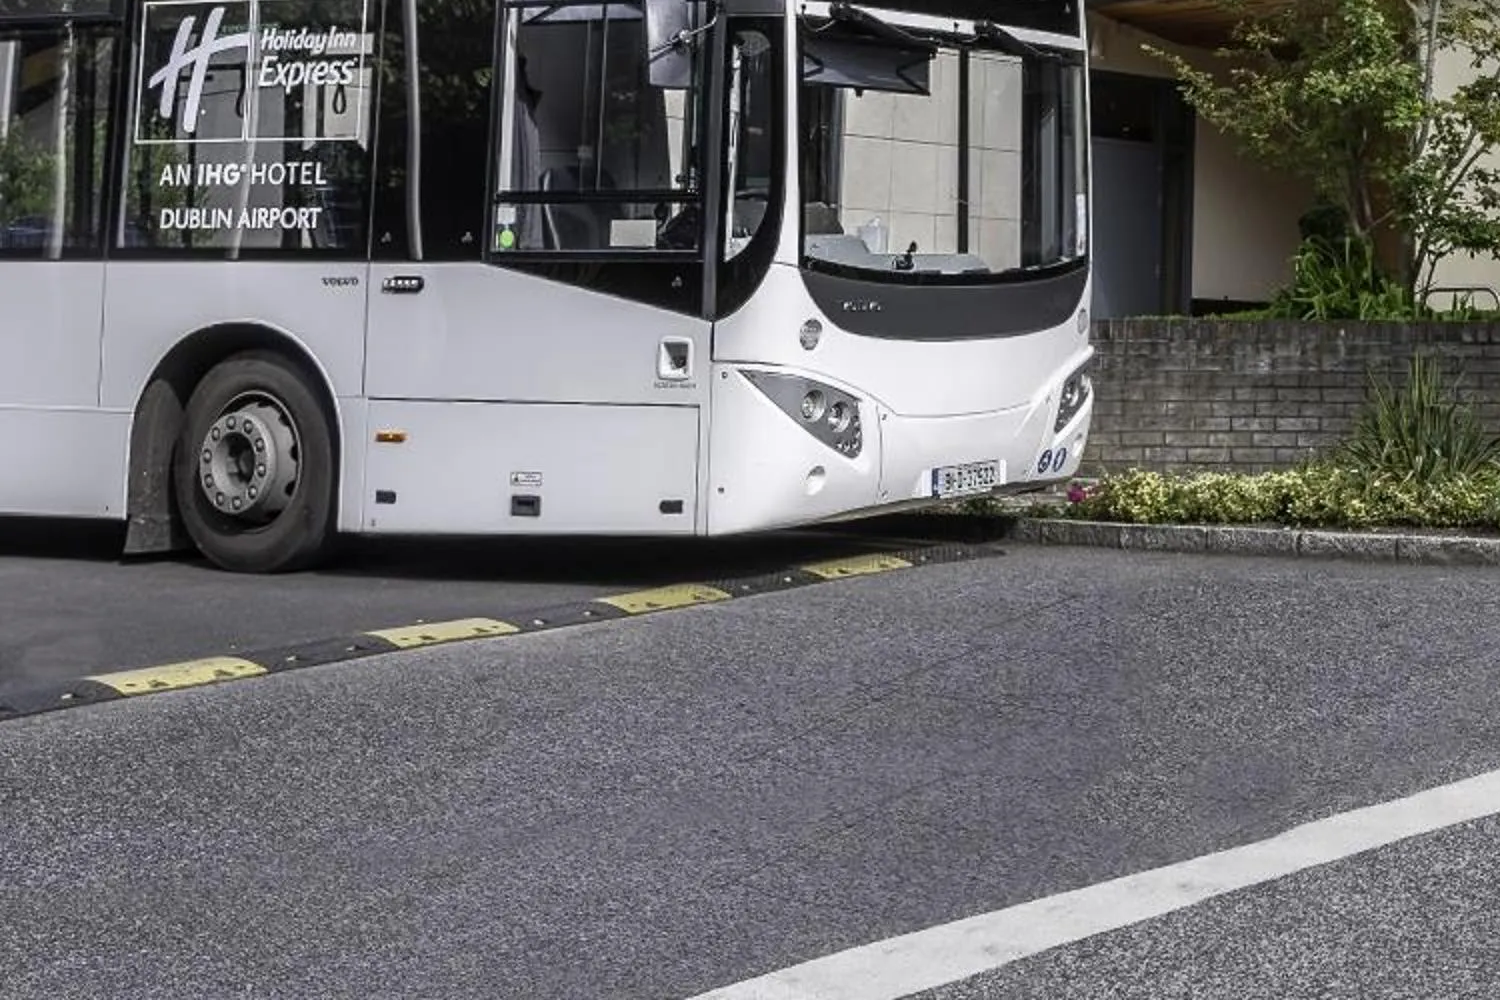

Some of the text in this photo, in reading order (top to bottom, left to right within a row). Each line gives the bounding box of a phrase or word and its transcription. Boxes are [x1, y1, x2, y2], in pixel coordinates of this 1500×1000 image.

[261, 27, 326, 54] Holiday
[325, 25, 356, 48] Inn
[258, 56, 354, 94] Express
[159, 164, 191, 187] AN
[251, 162, 327, 185] HOTEL
[159, 207, 323, 229] DUBLIN AIRPORT
